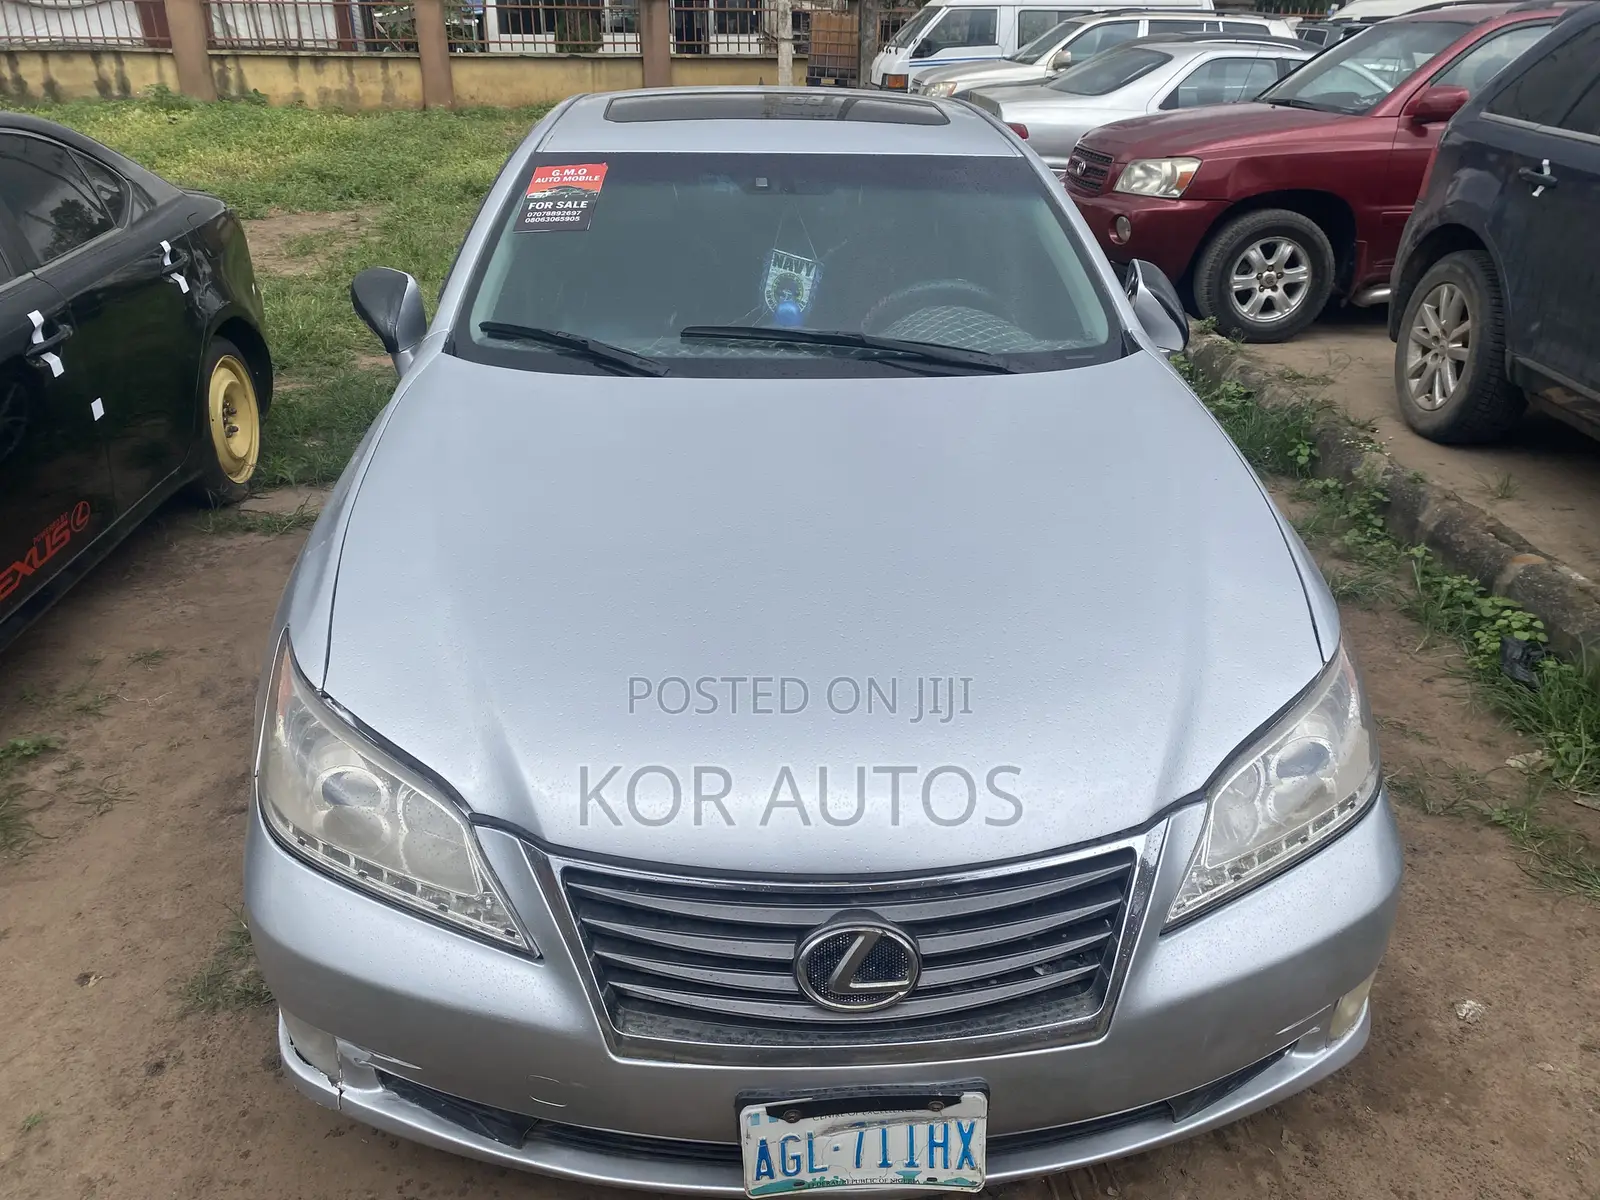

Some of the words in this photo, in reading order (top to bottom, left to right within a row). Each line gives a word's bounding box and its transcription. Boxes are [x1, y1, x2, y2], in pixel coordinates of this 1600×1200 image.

[551, 168, 587, 176] G.M.O
[528, 202, 554, 210] FOR
[556, 200, 588, 209] SALE
